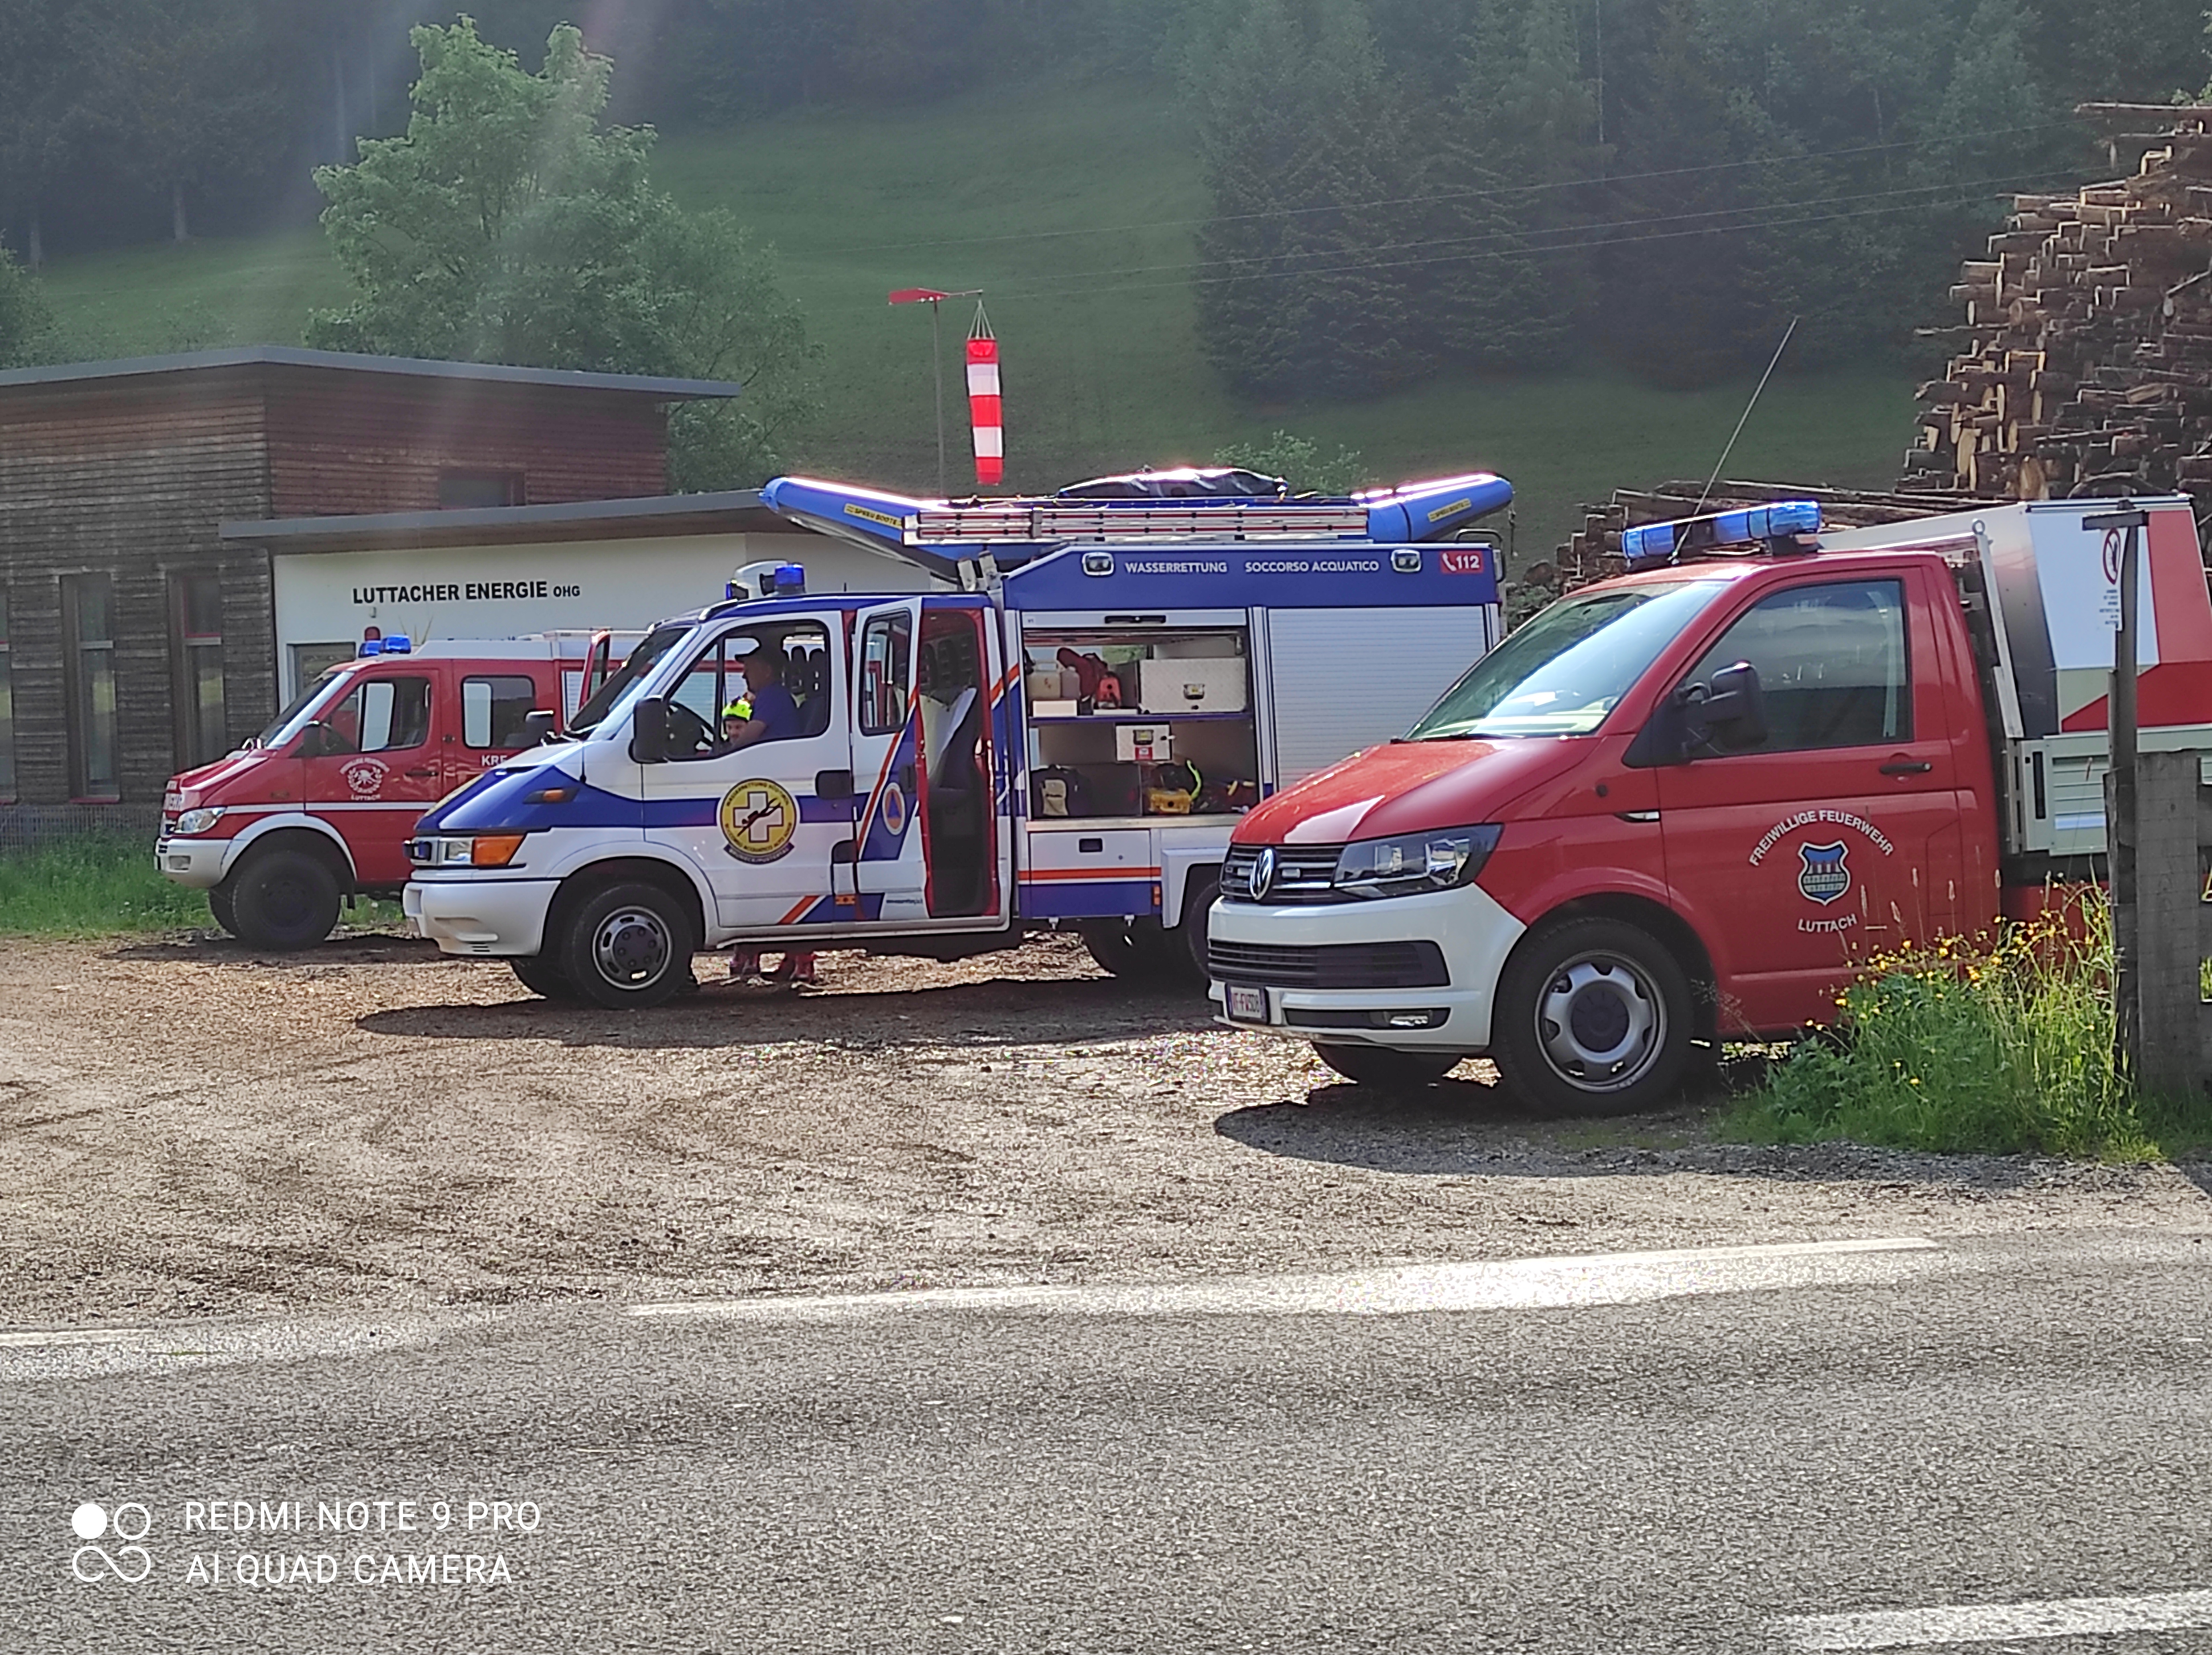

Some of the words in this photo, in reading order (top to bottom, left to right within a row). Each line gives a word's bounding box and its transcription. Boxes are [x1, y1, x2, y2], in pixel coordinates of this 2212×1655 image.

[1125, 562, 1228, 573] WASSERRETTUNG
[1245, 562, 1309, 572] SOCCORSO
[1311, 561, 1380, 572] ACQUATICO
[1456, 555, 1480, 570] 112
[353, 584, 460, 604] LUTTACHER
[466, 581, 548, 600] ENERGIE
[553, 585, 581, 597] OHG
[1749, 810, 1817, 867] FREIWILLIGE
[1819, 809, 1895, 856] FEUERWEHR
[1797, 913, 1858, 933] LUTTACH
